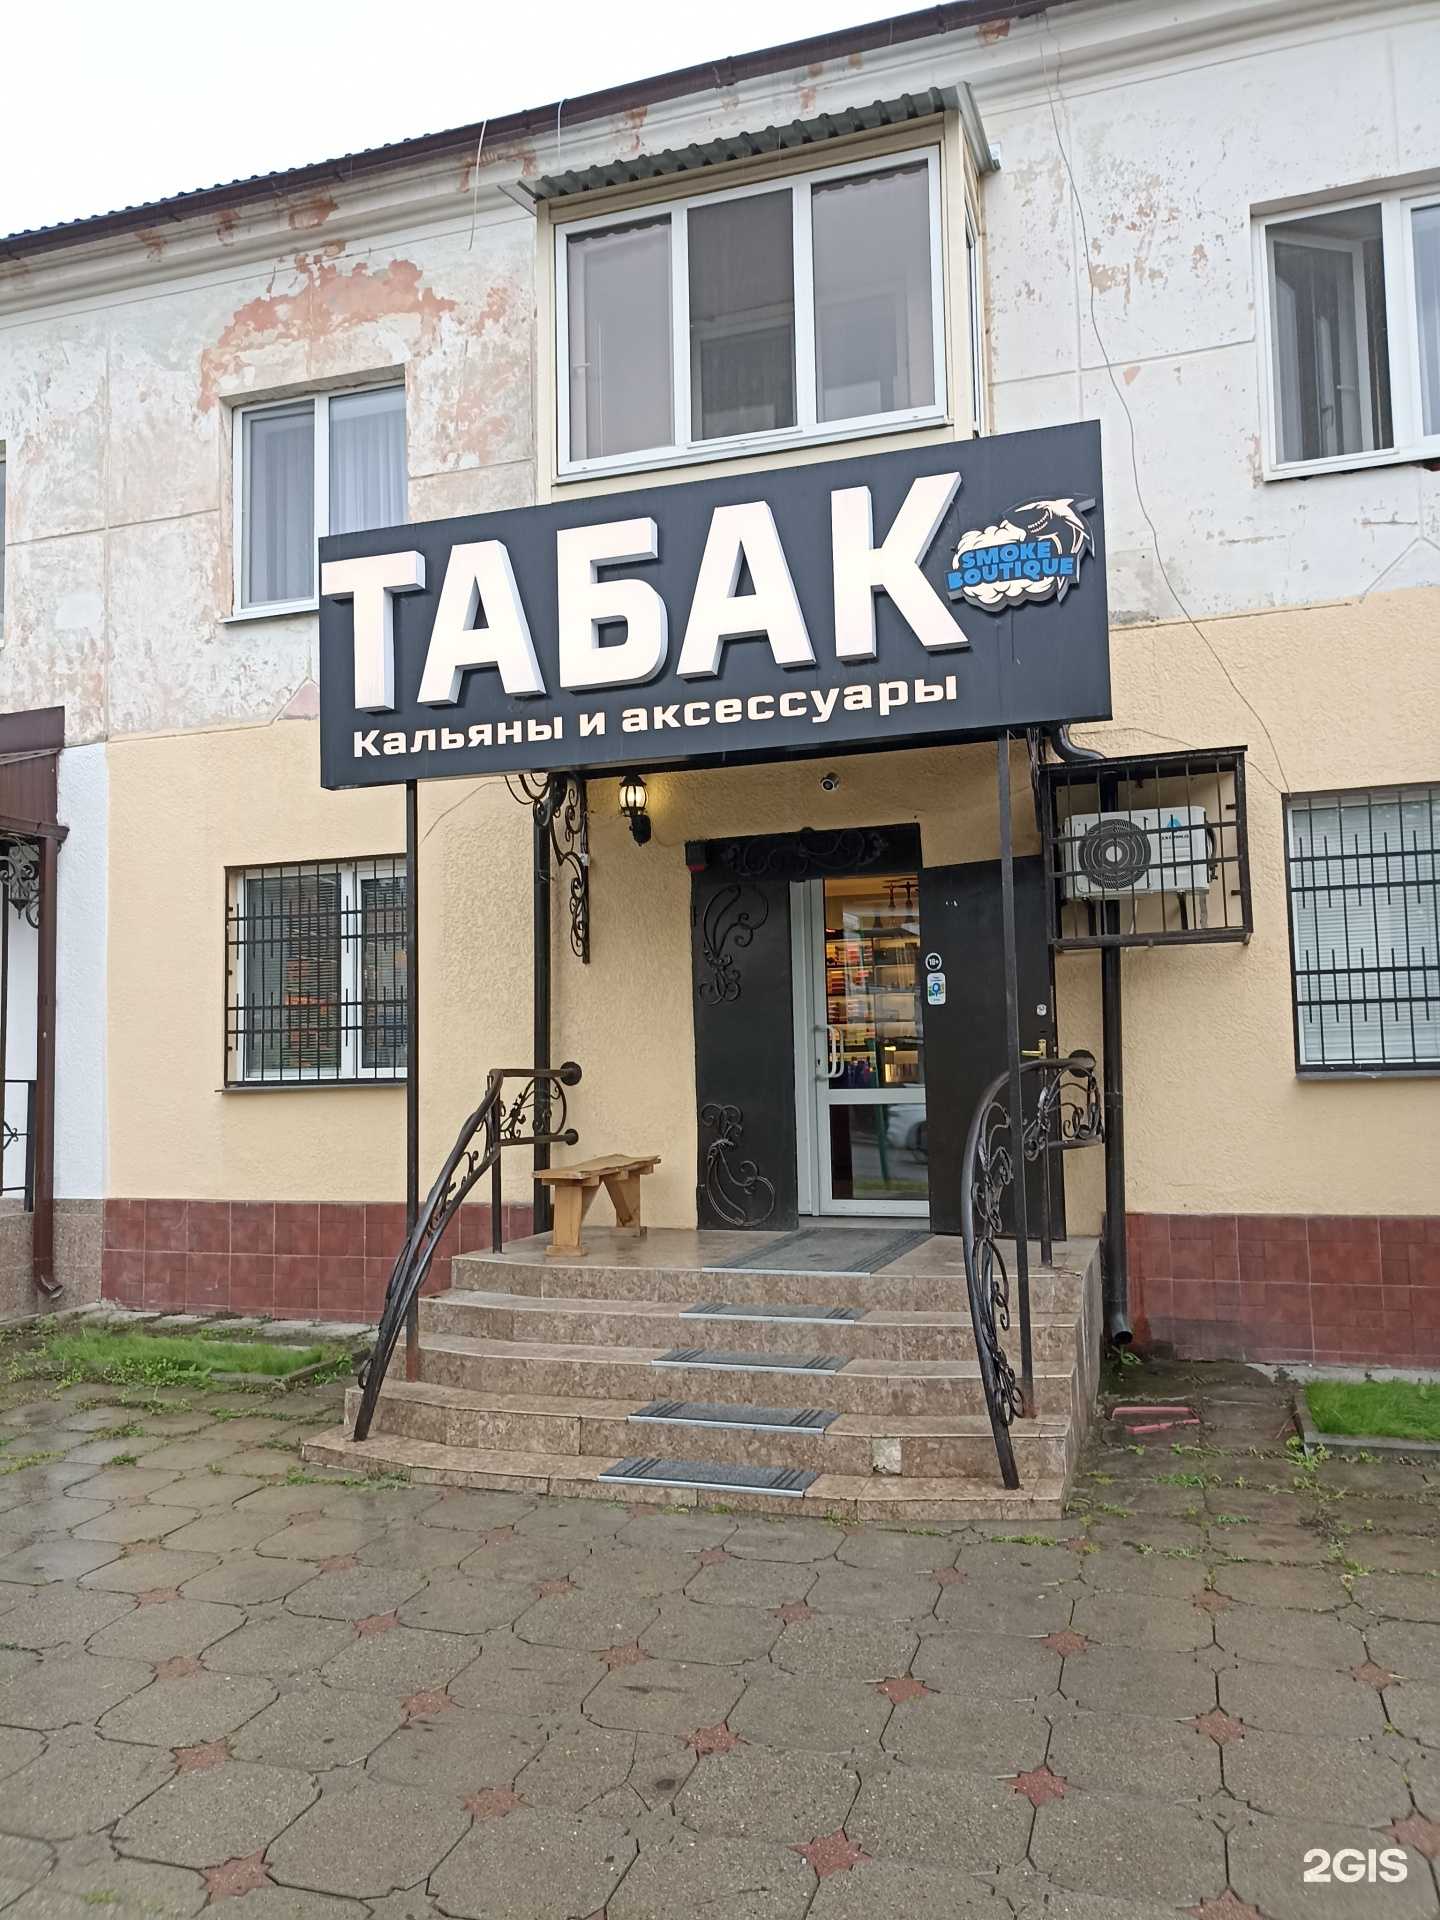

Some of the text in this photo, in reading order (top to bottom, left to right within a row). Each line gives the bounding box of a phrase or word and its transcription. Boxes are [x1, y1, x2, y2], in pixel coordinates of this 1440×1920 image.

[947, 557, 1074, 590] BOUTIQUE
[961, 541, 1051, 568] SMOKE
[321, 471, 969, 712] ТАБАК
[353, 675, 957, 758] Кальяны и аксессуары
